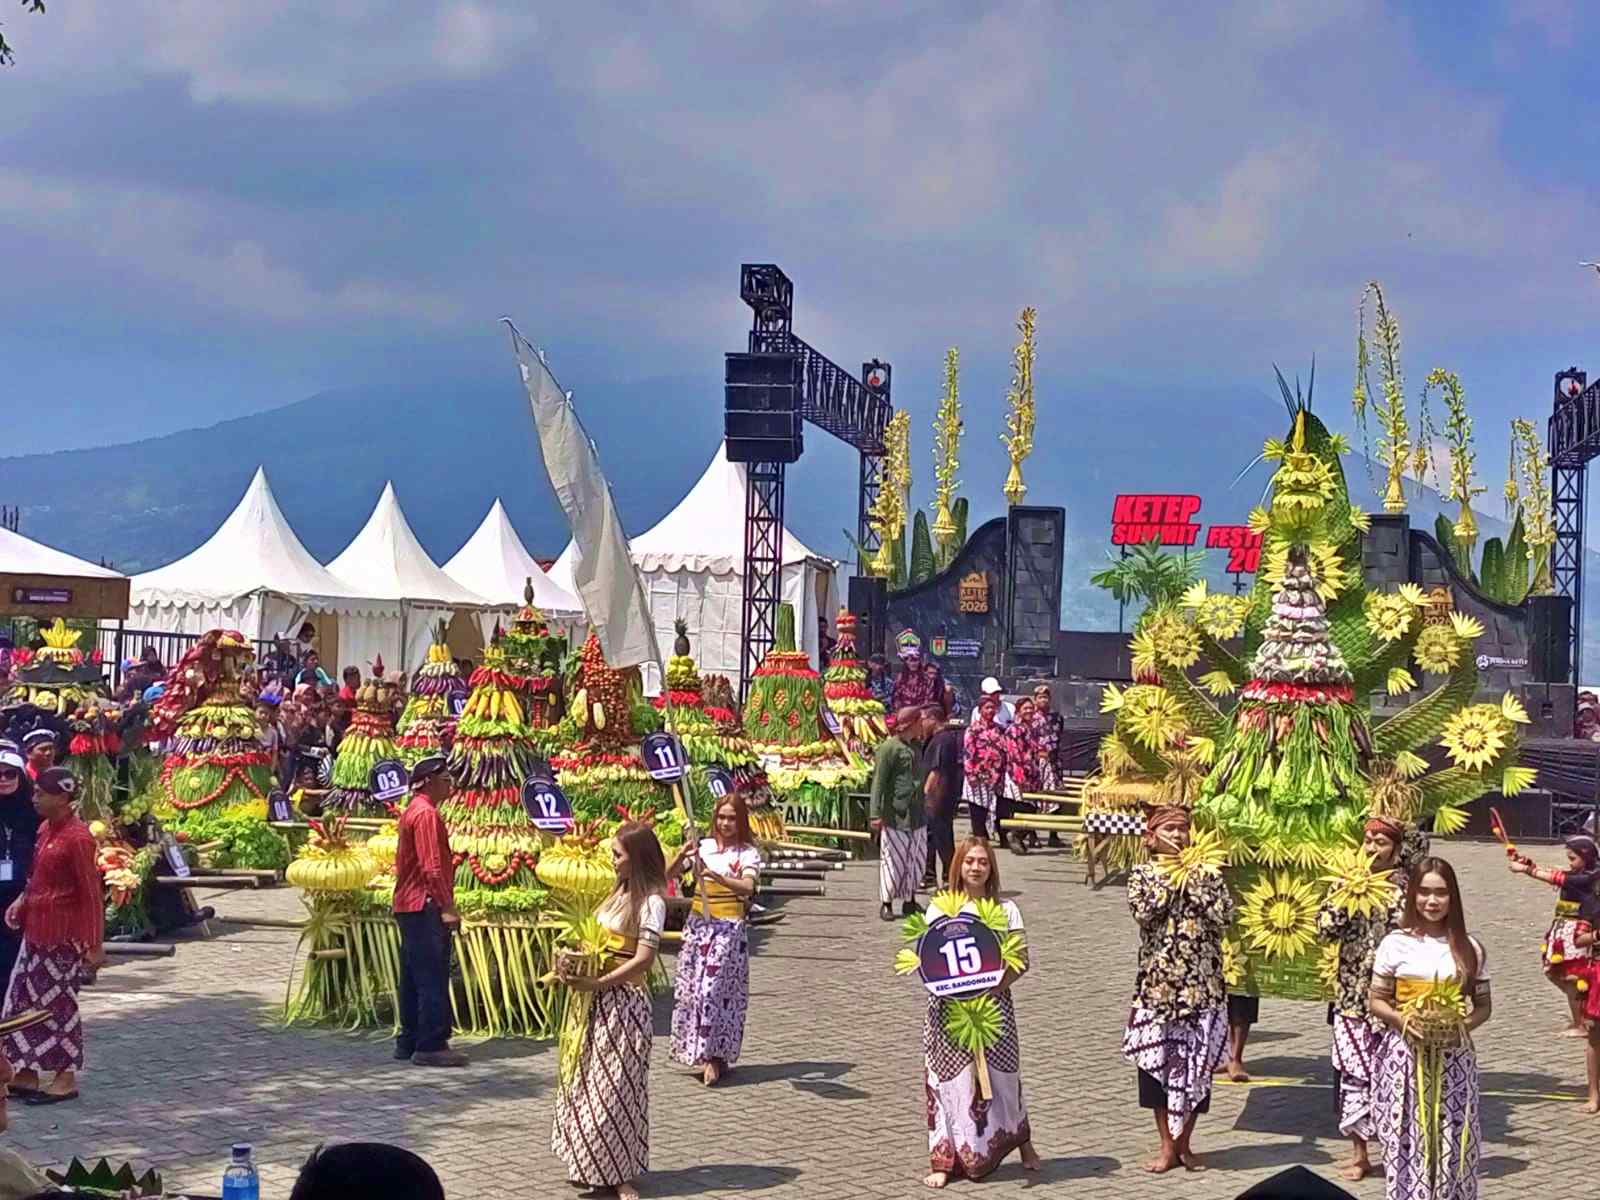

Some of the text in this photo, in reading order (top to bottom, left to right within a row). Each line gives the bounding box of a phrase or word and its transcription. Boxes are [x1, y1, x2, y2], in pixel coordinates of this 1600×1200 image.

[1112, 494, 1201, 524] KETEP
[1111, 524, 1201, 545] SUMMIT
[960, 601, 989, 612] 2026
[654, 745, 676, 768] 11
[377, 770, 400, 791] 03
[535, 793, 560, 817] 12
[939, 936, 982, 977] 15
[935, 983, 952, 992] KEC.
